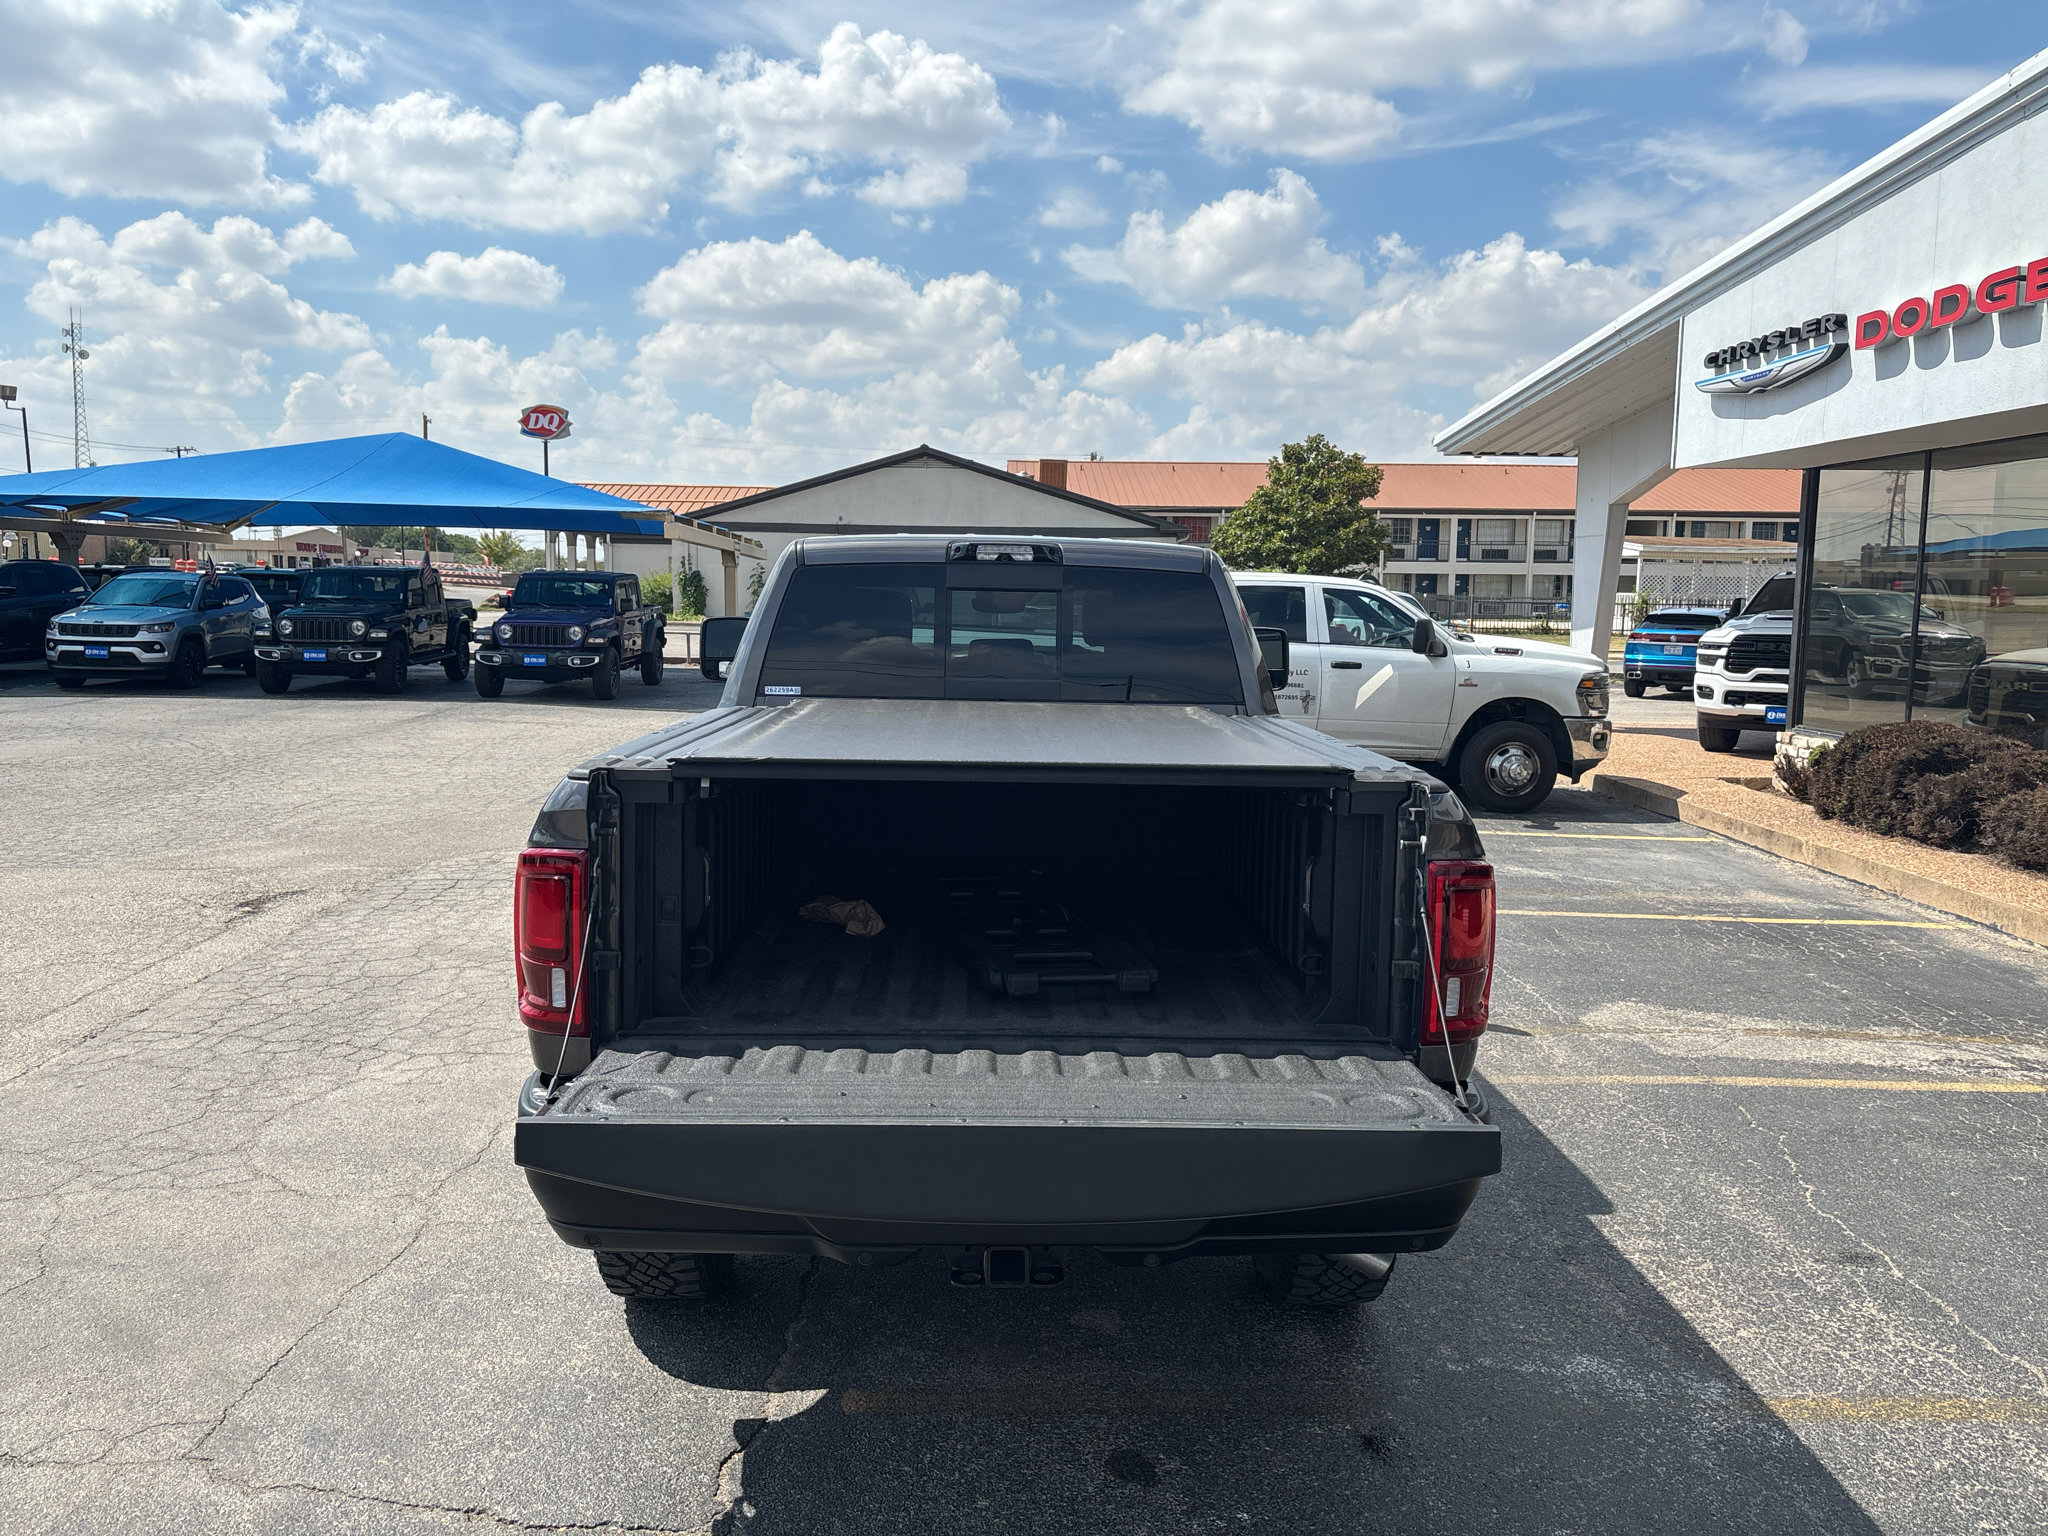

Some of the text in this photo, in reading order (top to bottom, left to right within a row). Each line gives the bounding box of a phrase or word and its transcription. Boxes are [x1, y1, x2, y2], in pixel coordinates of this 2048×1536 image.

[1854, 256, 2048, 351] DODGE
[1703, 313, 1845, 369] CHRYSLER
[527, 412, 560, 432] DQ
[1465, 660, 1471, 669] 3
